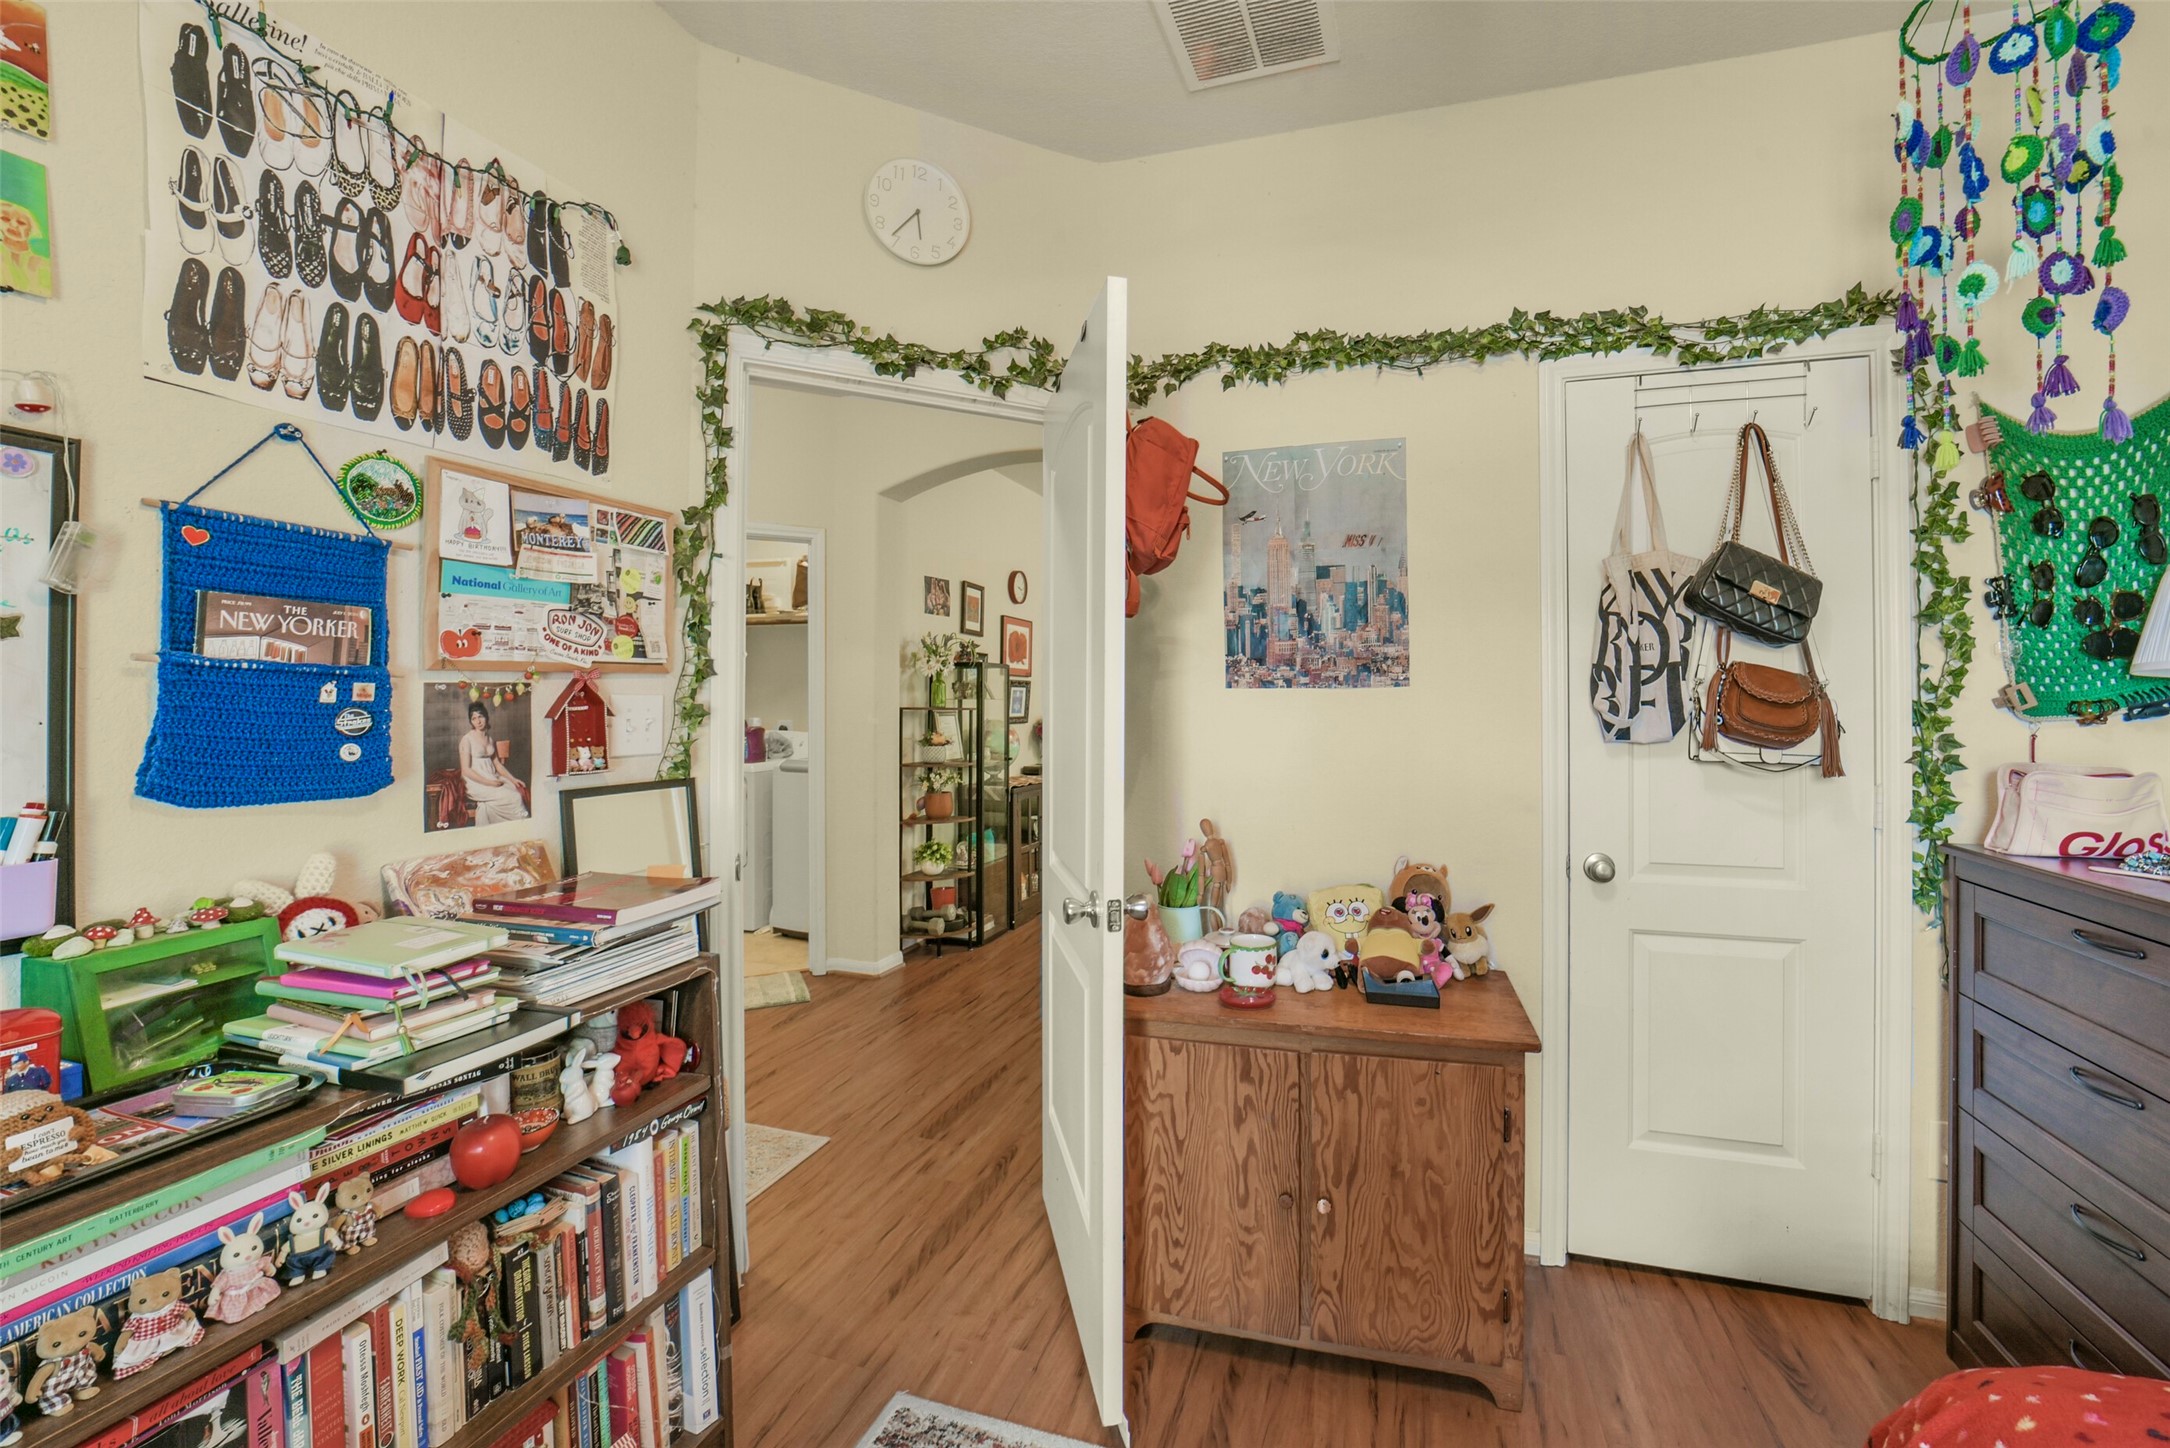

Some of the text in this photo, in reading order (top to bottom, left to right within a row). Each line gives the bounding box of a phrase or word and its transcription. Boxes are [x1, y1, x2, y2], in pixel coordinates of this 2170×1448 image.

[208, 0, 308, 53] alleine!
[876, 175, 892, 192] 10
[893, 165, 905, 181] 11
[912, 165, 928, 181] 12
[938, 178, 942, 192] 1
[869, 193, 880, 207] 9
[947, 195, 958, 210] 2
[875, 215, 885, 230] 8
[953, 217, 963, 231] 3
[891, 234, 901, 248] 7
[931, 245, 941, 259] 5
[946, 236, 955, 249] 4
[910, 245, 920, 260] 6
[1227, 446, 1407, 494] NEW YORK
[445, 539, 464, 548] HAPPY
[522, 532, 585, 549] MONTEREY
[451, 575, 563, 598] National Gallery of Art
[283, 605, 308, 615] THE
[219, 610, 359, 639] NEW YORKER
[552, 614, 576, 625] RON
[578, 620, 600, 636] JON
[556, 626, 591, 642] SURF SHOP
[544, 633, 559, 647] ONE
[562, 642, 572, 652] OF
[581, 647, 599, 657] KIND
[1639, 643, 1655, 651] KER
[454, 1070, 481, 1083] SONTAG
[512, 1072, 537, 1083] WALL
[38, 1127, 55, 1137] can't
[622, 1101, 705, 1148] 1984 George Orwell
[20, 1130, 66, 1151] ESPRESSO
[40, 1141, 56, 1152] much
[56, 1139, 67, 1147] you
[321, 1149, 354, 1167] SILVER
[357, 1131, 393, 1152] LININGS
[400, 1119, 429, 1136] MATTHEW
[431, 1112, 447, 1123] QUICK
[22, 1151, 44, 1163] bean
[46, 1148, 53, 1156] to
[392, 1166, 403, 1175] for
[628, 1185, 637, 1224] CLEOPATRA
[669, 1139, 680, 1265] INTERMEZZO SALLY ROONEY
[16, 1242, 54, 1263] CENTURY
[57, 1234, 72, 1246] ART
[109, 1200, 159, 1224] BATTERBERRY
[646, 1195, 655, 1265] Blue Sisters
[592, 1225, 601, 1265] AMERICANS
[521, 1256, 531, 1268] THE
[544, 1256, 552, 1274] SONG
[631, 1235, 639, 1286] FRANKENSTEIN
[22, 1270, 69, 1295] AUCOIN
[522, 1268, 531, 1284] GIRL
[6, 1300, 71, 1344] AMERICAN
[75, 1266, 148, 1311] COLLECTION
[513, 1269, 525, 1322] DRAGON TATTOO
[543, 1285, 555, 1318] SOLOMON
[395, 1318, 404, 1348] DEEP
[522, 1331, 531, 1380] STIEG LARSSON
[359, 1339, 370, 1413] Ottessa Moshfegh
[397, 1350, 406, 1387] WORK
[414, 1357, 423, 1380] FIRST
[149, 1364, 237, 1423] all about love
[184, 1382, 228, 1411] Morrison
[290, 1373, 303, 1400] THE
[415, 1381, 425, 1398] AID
[291, 1398, 304, 1429] BELL
[379, 1376, 391, 1434] FAHRENHEIT
[398, 1404, 407, 1438] Newport
